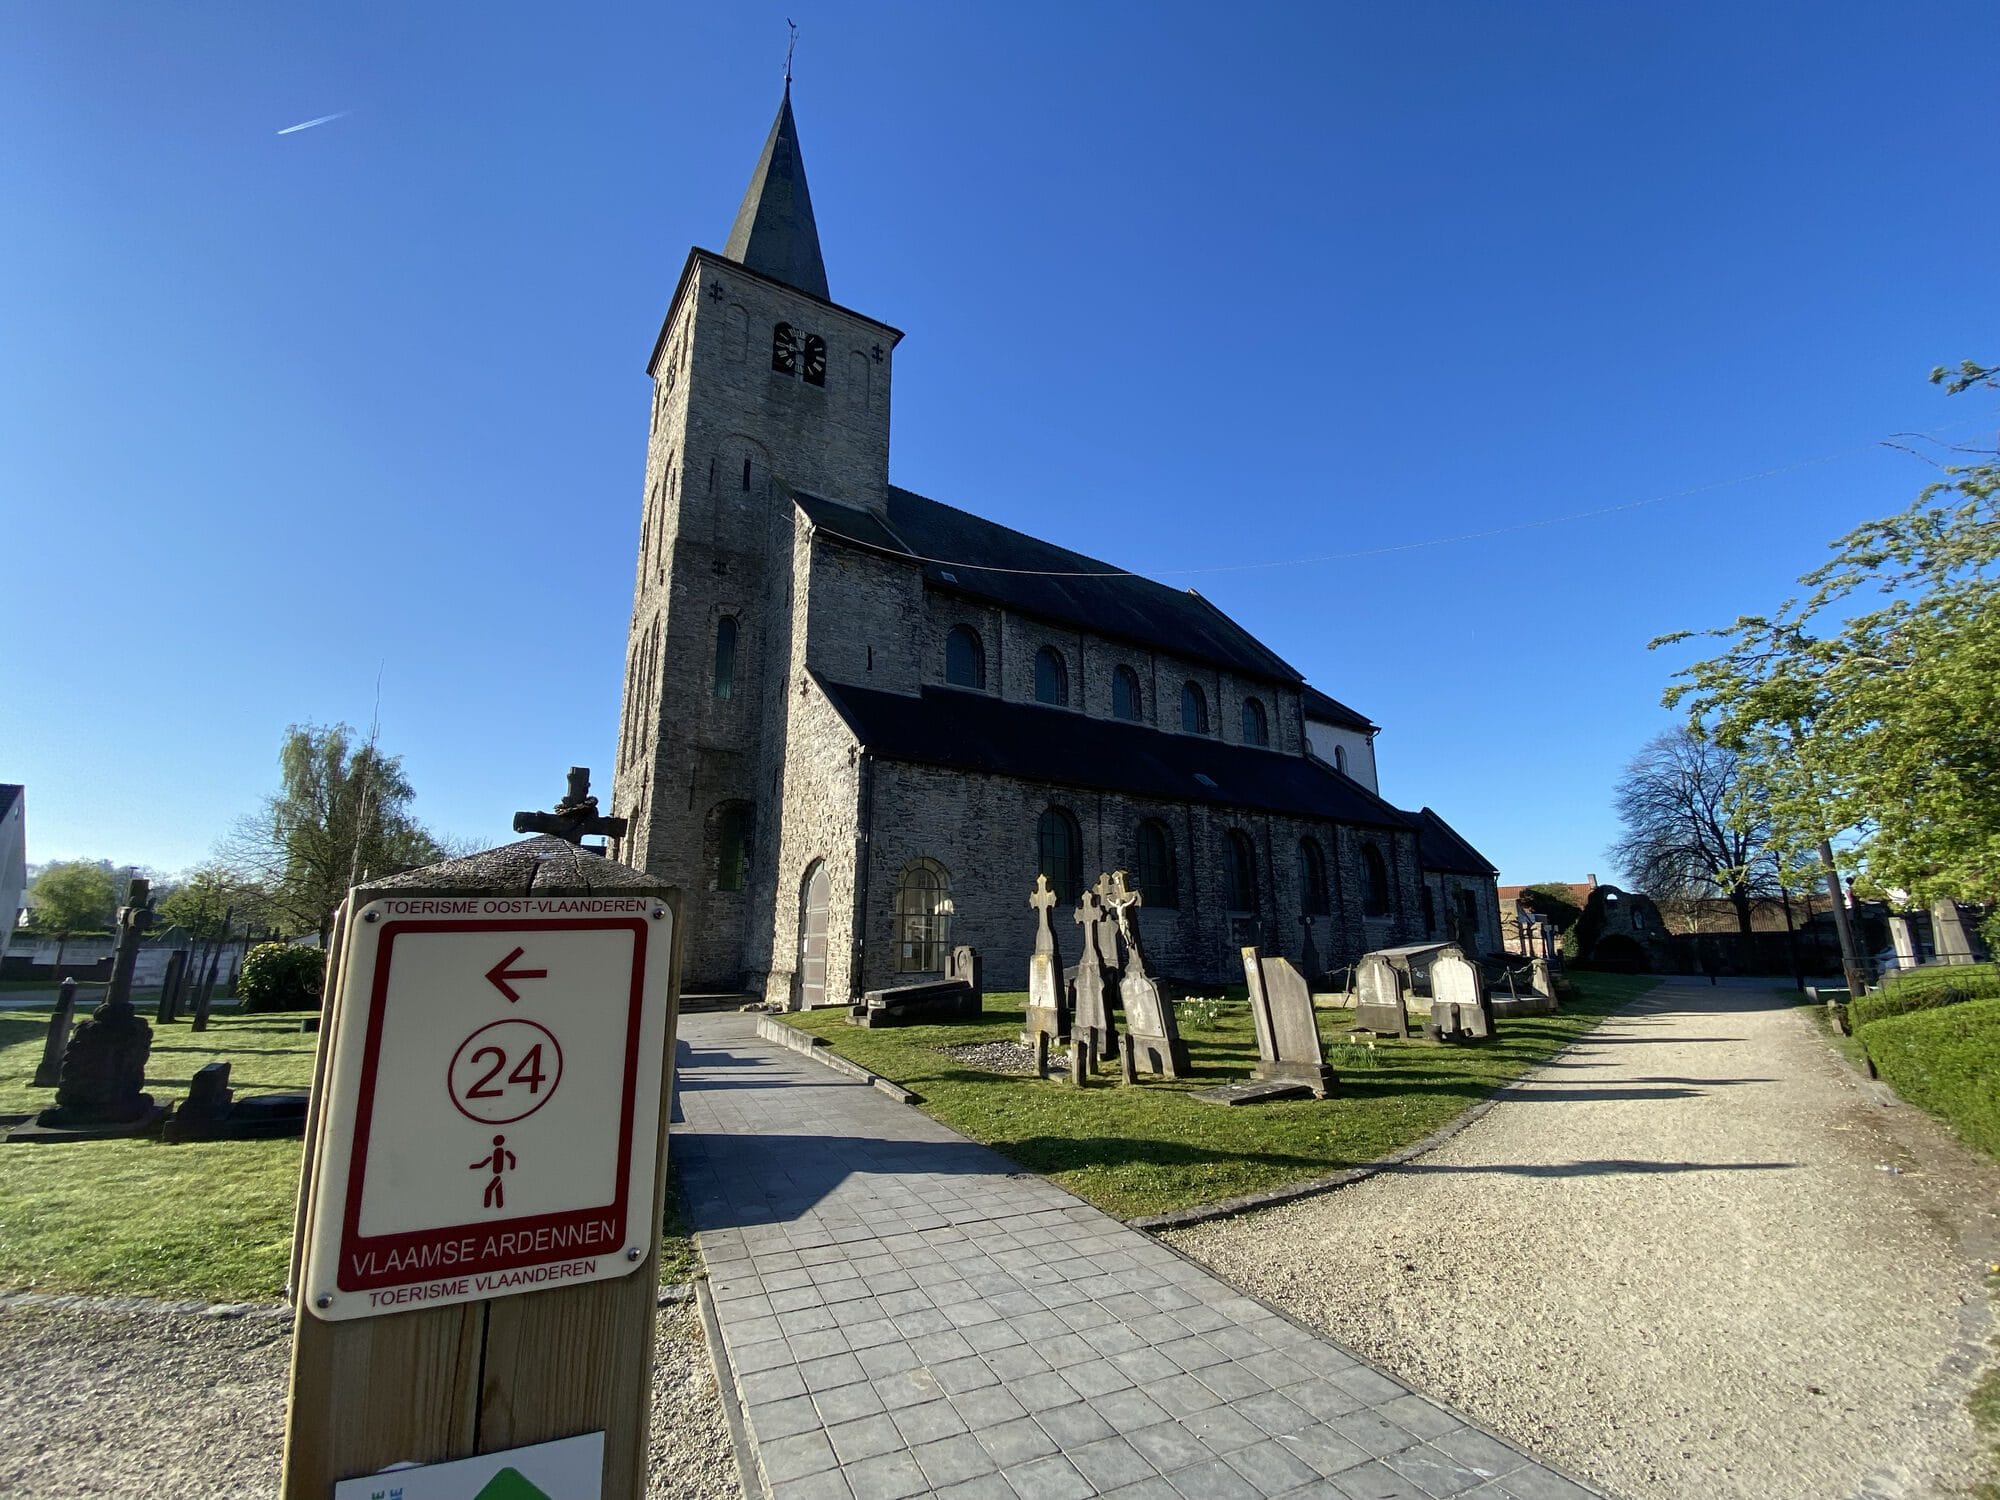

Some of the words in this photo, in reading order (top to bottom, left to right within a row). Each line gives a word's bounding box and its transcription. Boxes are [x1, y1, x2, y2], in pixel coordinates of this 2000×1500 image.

[384, 900, 480, 914] TOERISME
[484, 900, 647, 914] OOST-VLAANDEREN
[465, 1043, 546, 1099] 24
[353, 1238, 476, 1277] VLAAMSE
[481, 1219, 616, 1259] ARDENNEN
[369, 1279, 469, 1307] TOERISME
[475, 1260, 596, 1291] VLAANDEREN
